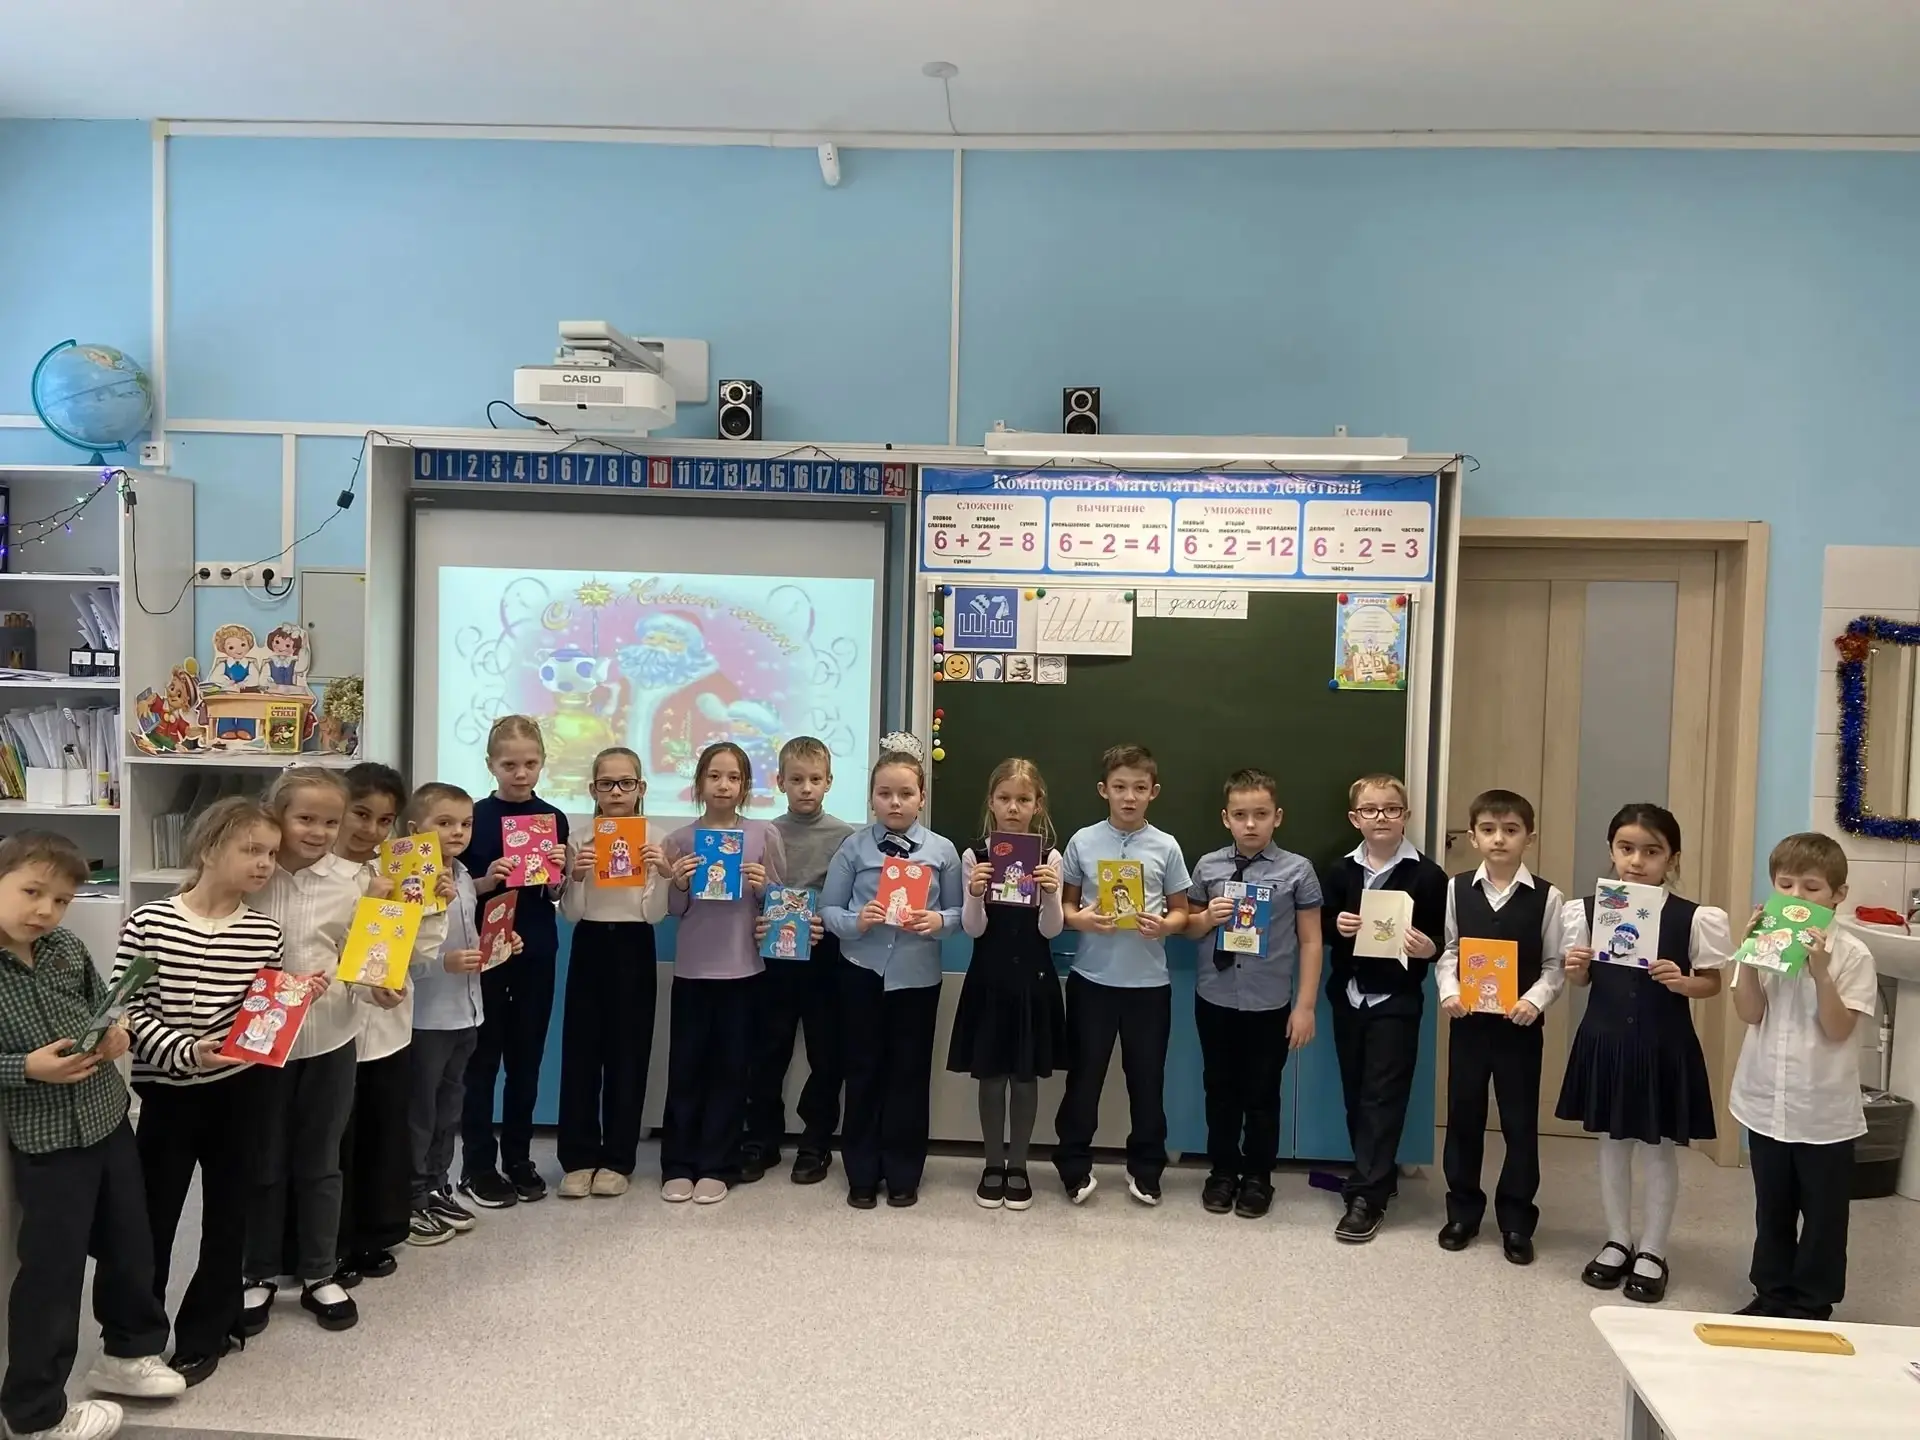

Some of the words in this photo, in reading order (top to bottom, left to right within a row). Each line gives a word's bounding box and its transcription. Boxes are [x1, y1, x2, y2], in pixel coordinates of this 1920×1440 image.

[562, 374, 601, 384] CASIO
[421, 452, 431, 476] 0
[446, 454, 453, 477] 1
[468, 453, 477, 478] 2
[491, 454, 501, 479] 3
[513, 455, 525, 480] 4
[537, 456, 547, 480] 5
[561, 457, 571, 481] 6
[584, 457, 595, 482] 7
[607, 458, 618, 483] 8
[631, 459, 641, 483] 9
[652, 461, 668, 485] 10
[678, 461, 690, 485] 11
[699, 462, 714, 486] 12
[723, 463, 738, 487] 13
[745, 463, 762, 487] 14
[769, 464, 785, 488] 15
[793, 465, 808, 489] 16
[816, 466, 832, 490] 17
[840, 466, 855, 490] 18
[885, 468, 904, 492] 20
[991, 474, 1110, 492] Компоненты
[1116, 476, 1270, 495] математических
[1273, 479, 1363, 496] действий
[957, 502, 1014, 510] сложение
[1076, 503, 1146, 513] вычитание
[1204, 506, 1273, 516] умножение
[1343, 507, 1393, 517] деление
[934, 530, 948, 550] 6
[977, 531, 991, 551] 2
[1022, 532, 1035, 552] 8
[1059, 533, 1073, 553] 6
[1102, 533, 1116, 553] 2
[1146, 534, 1161, 554] 4
[1183, 535, 1198, 555] 6
[1223, 536, 1238, 555] 2
[1266, 536, 1294, 556] 12
[1313, 537, 1327, 557] 6
[1358, 538, 1373, 557] 2
[1404, 538, 1419, 558] 3
[1168, 590, 1240, 616] декабря
